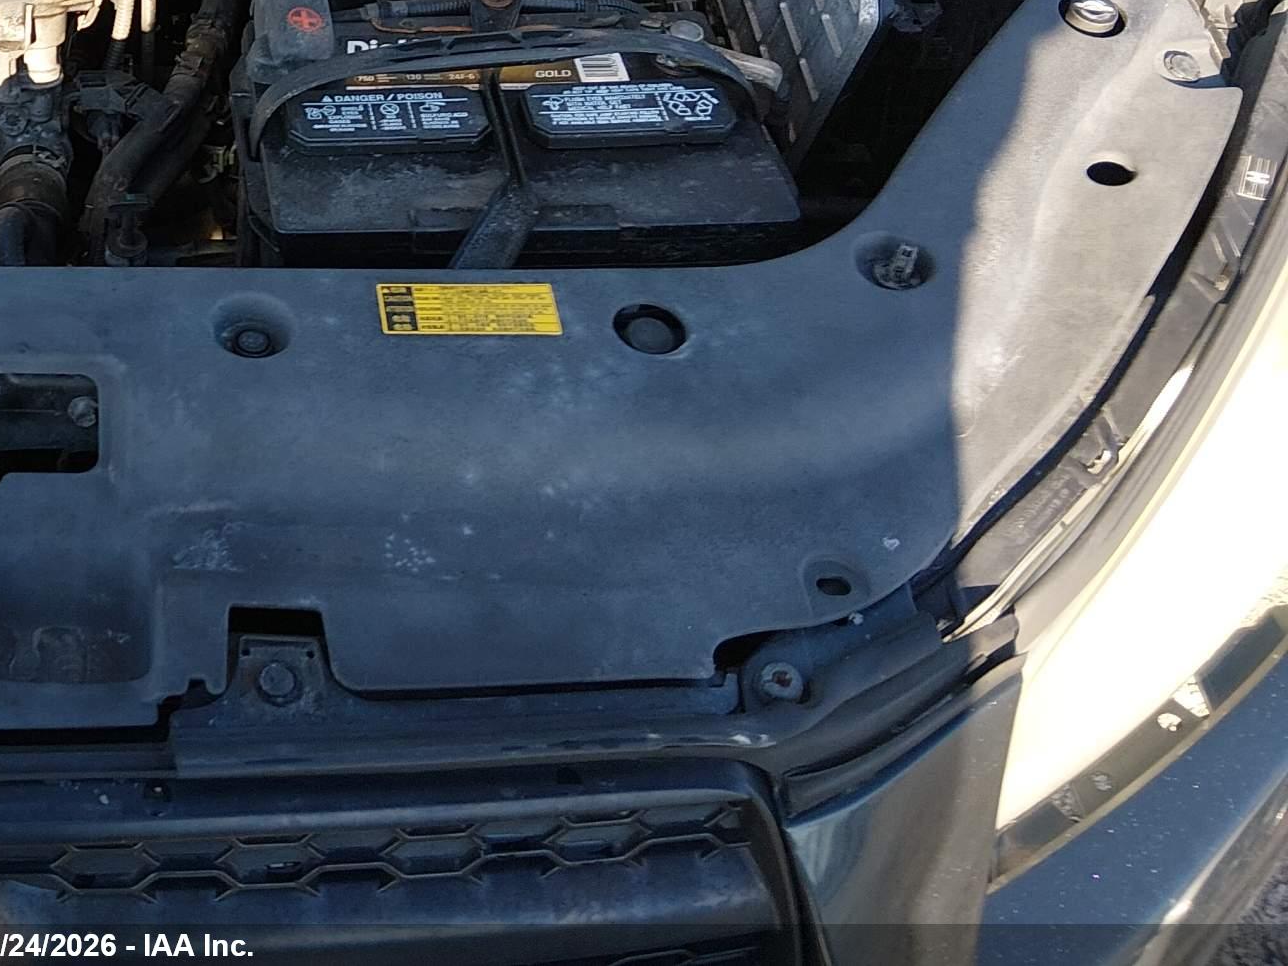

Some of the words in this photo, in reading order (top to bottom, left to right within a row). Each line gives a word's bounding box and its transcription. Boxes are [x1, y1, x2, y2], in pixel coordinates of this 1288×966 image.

[535, 70, 572, 78] GOLD
[334, 94, 385, 102] DANGER
[397, 92, 443, 101] POISON
